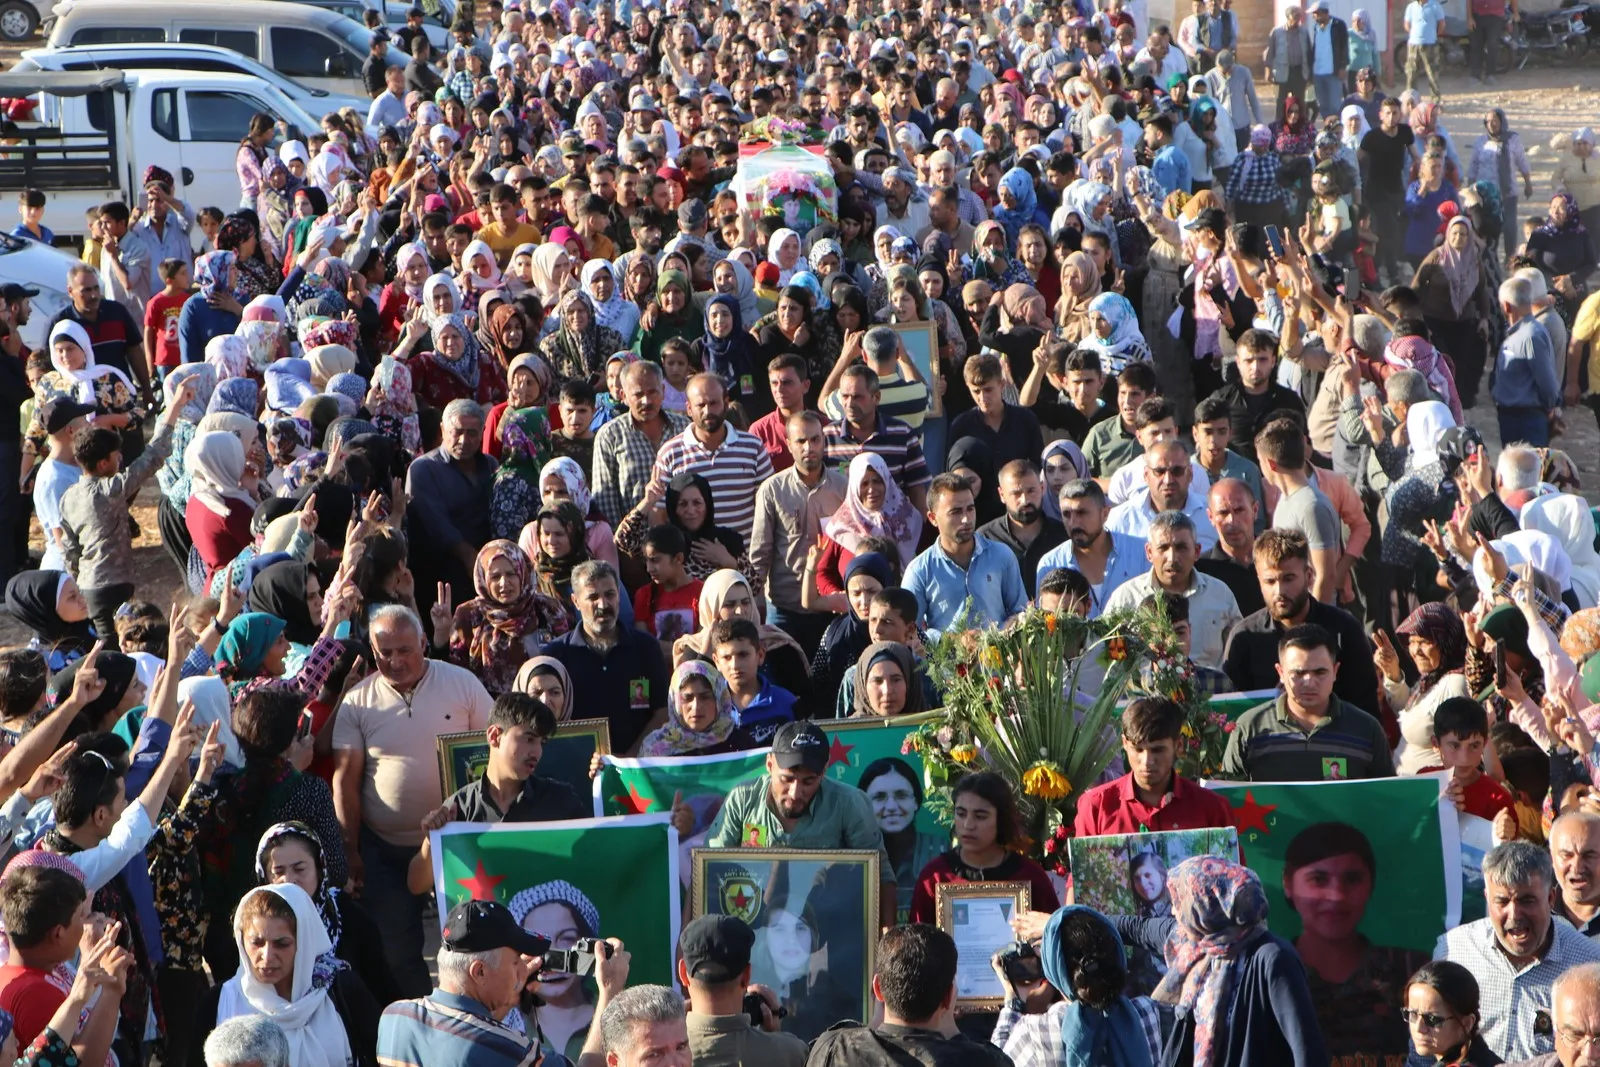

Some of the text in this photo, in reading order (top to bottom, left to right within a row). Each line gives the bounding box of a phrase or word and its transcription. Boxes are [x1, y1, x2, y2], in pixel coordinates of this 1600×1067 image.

[836, 765, 846, 779] P
[1249, 816, 1277, 843] P J
[501, 888, 507, 899] J
